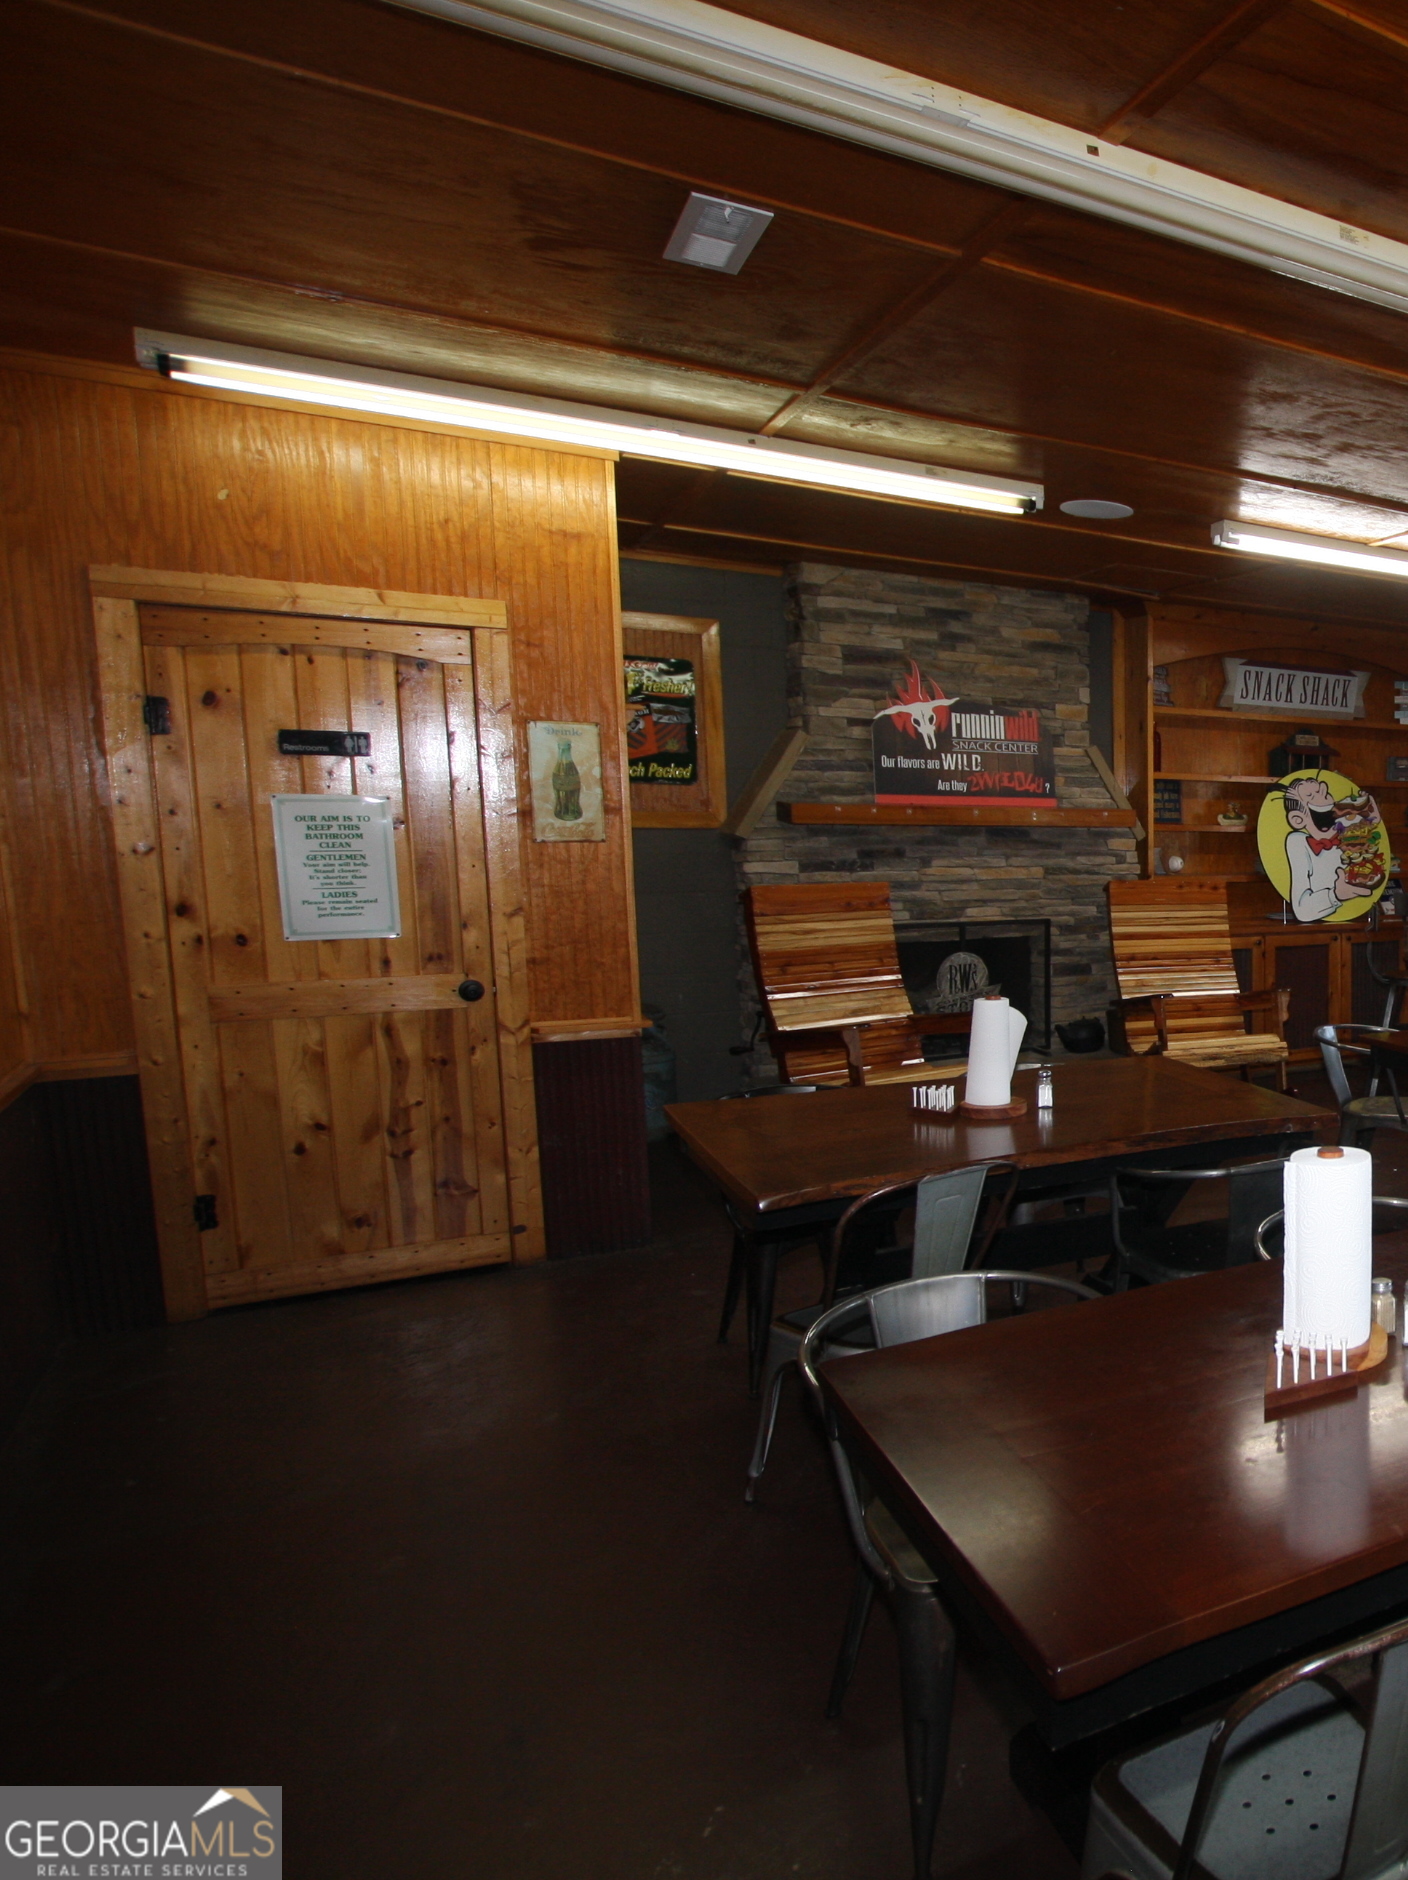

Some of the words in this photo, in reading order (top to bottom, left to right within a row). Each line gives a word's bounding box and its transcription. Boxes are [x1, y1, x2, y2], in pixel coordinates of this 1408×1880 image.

[1240, 669, 1297, 704] SNACK
[1299, 675, 1351, 708] SHACK
[282, 743, 330, 752] Restrooms
[952, 740, 991, 751] SNACK
[994, 743, 1038, 753] CENTER
[881, 754, 896, 768] Our
[897, 755, 926, 769] flavors
[927, 759, 940, 769] are
[941, 752, 985, 772] WILD.
[628, 762, 646, 777] ch
[647, 761, 692, 778] Packed
[937, 779, 950, 791] Are
[951, 779, 967, 793] they
[319, 841, 352, 849] CLEAN
[321, 891, 358, 899] LADIES
